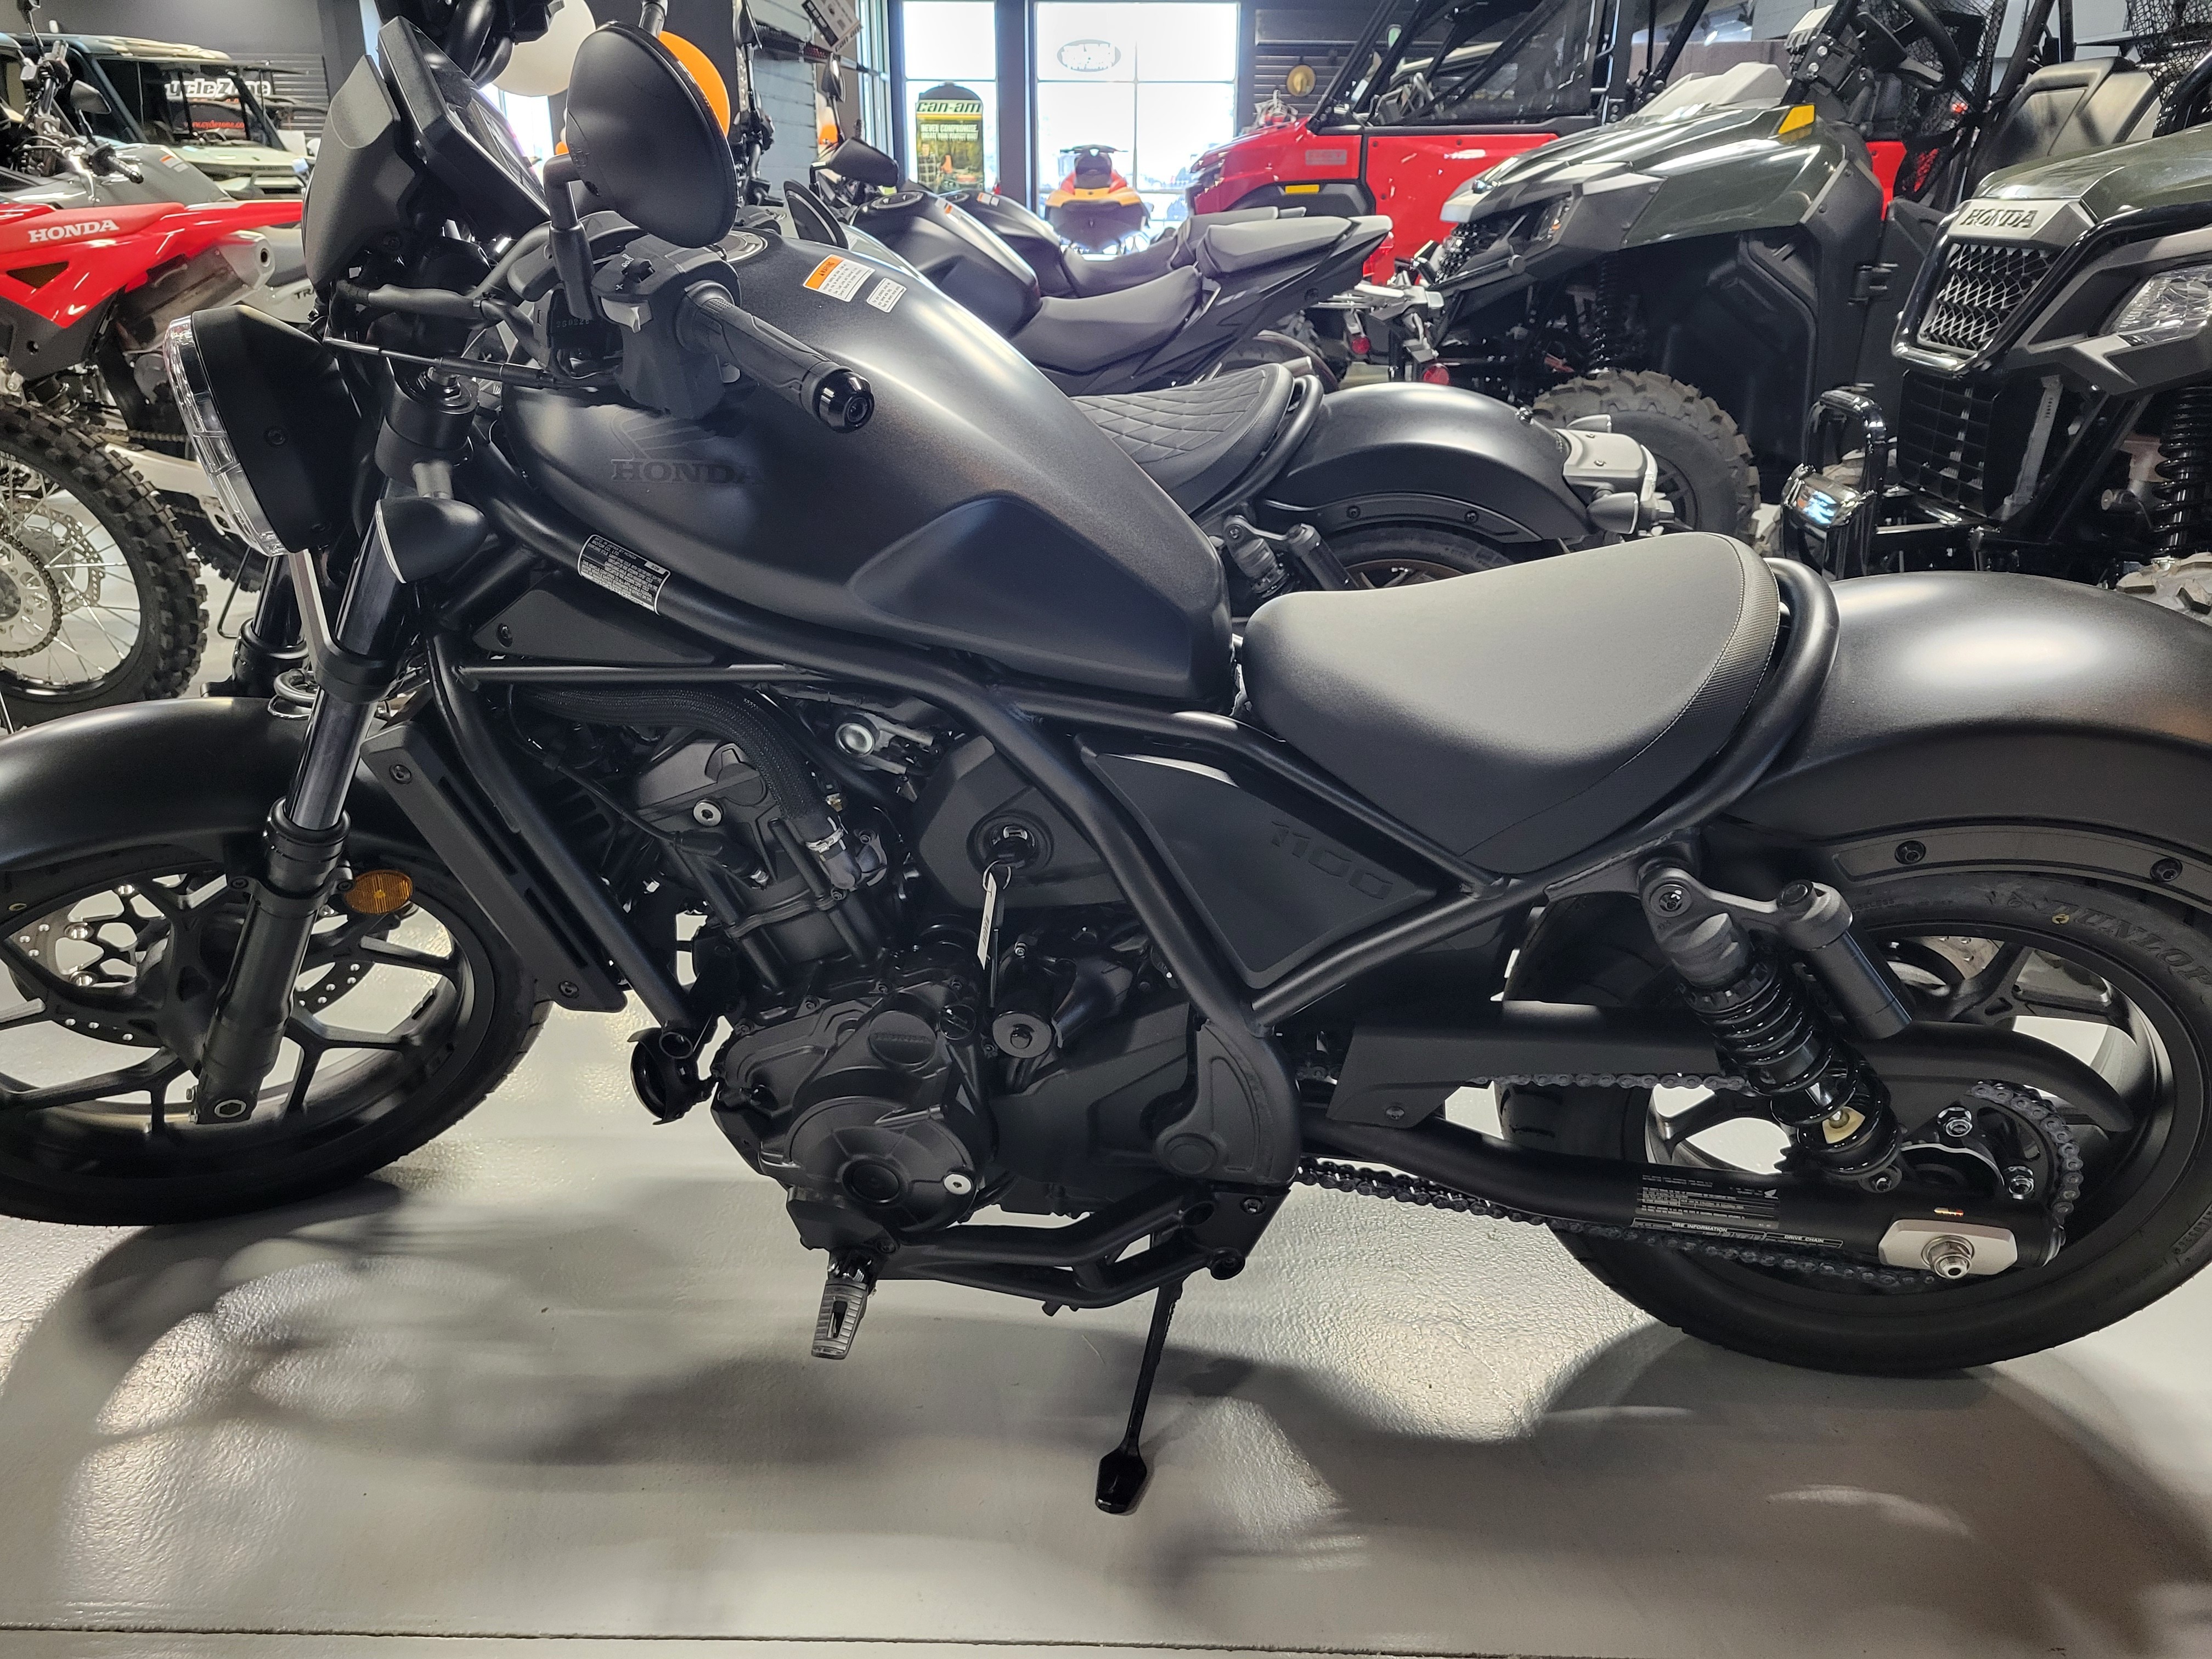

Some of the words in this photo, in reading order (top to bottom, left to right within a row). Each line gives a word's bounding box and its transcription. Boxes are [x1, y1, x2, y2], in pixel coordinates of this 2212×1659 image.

[917, 103, 980, 112] can-am
[1959, 208, 2038, 228] HONDA
[28, 219, 120, 242] HONDA
[591, 539, 605, 549] MOTOR
[1271, 821, 1394, 900] 1100
[1687, 1224, 1728, 1233] INFORMATION
